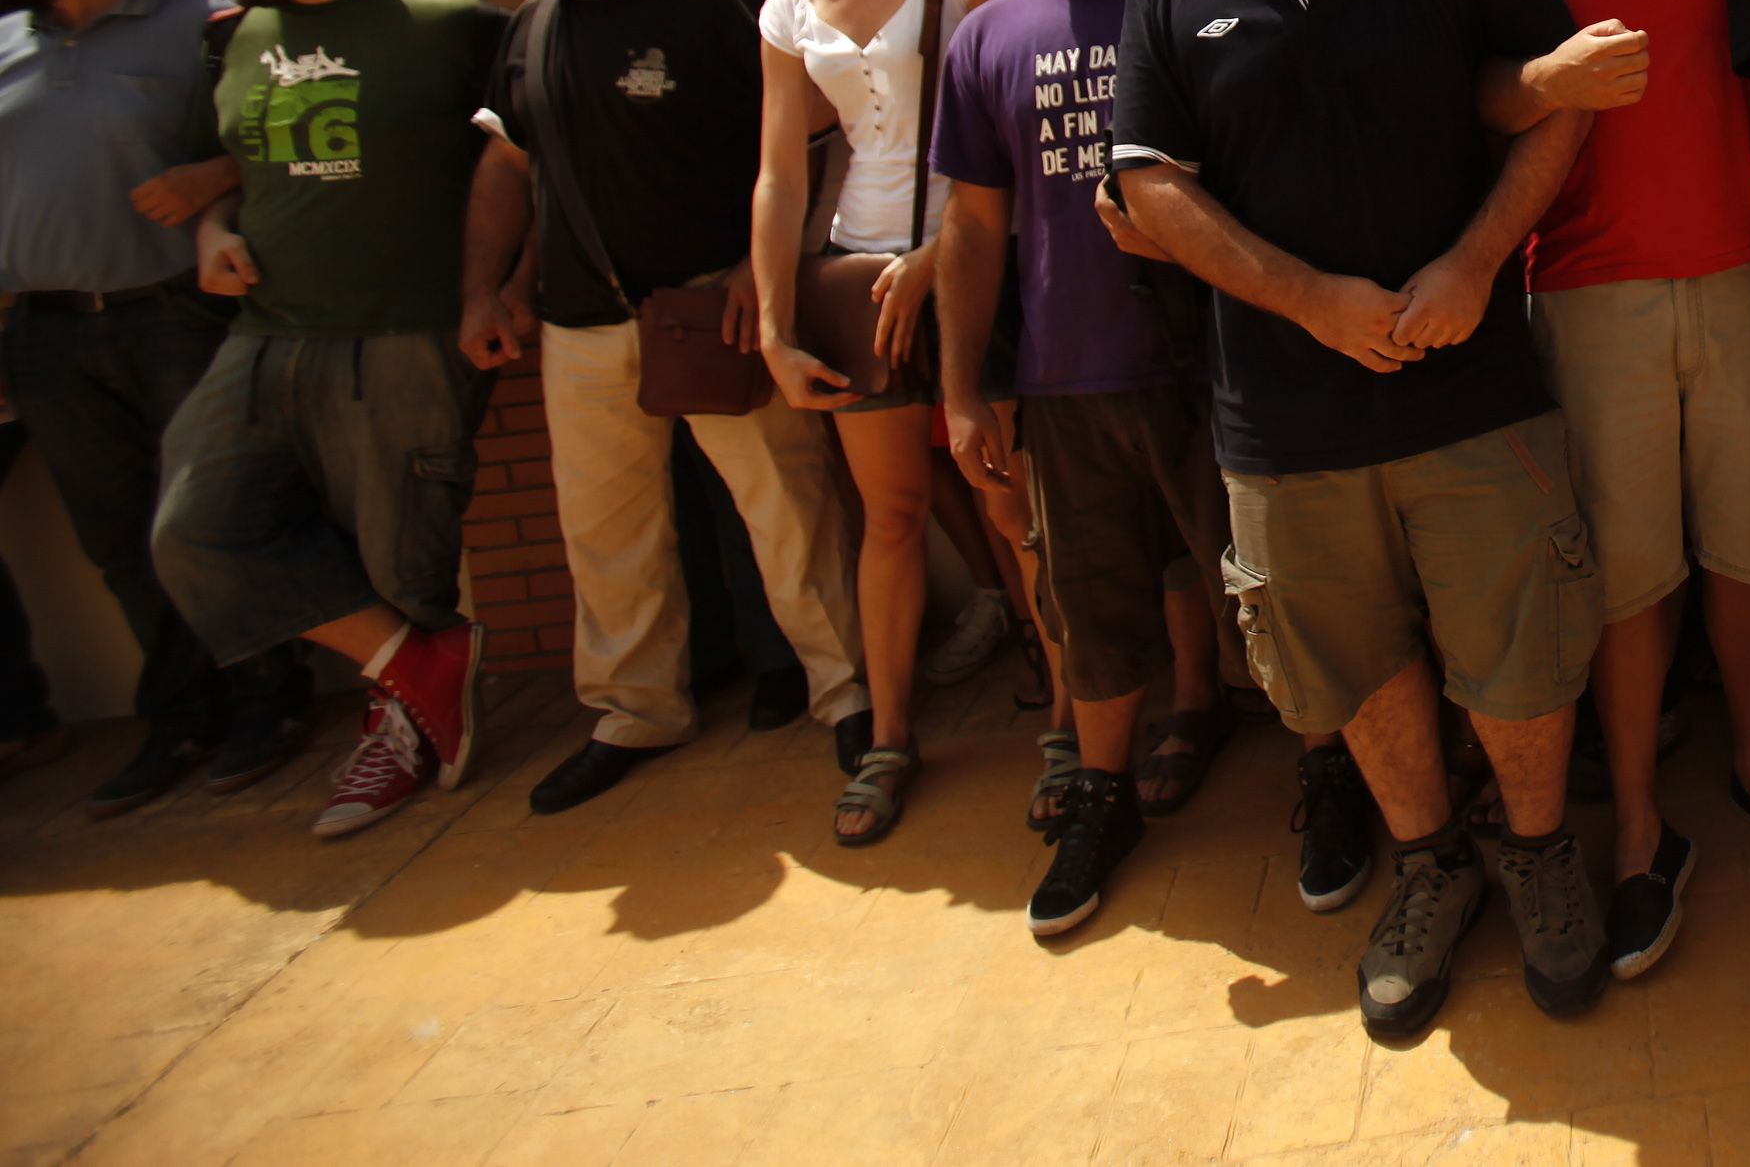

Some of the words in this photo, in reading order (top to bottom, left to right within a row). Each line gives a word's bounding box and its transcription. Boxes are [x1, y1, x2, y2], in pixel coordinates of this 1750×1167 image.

[1035, 47, 1080, 77] MAY
[1089, 44, 1117, 69] DA
[1035, 83, 1064, 110] NO
[1039, 118, 1055, 143] A
[1063, 110, 1098, 139] FIN
[1041, 147, 1070, 176] DE
[1078, 142, 1106, 170] ME
